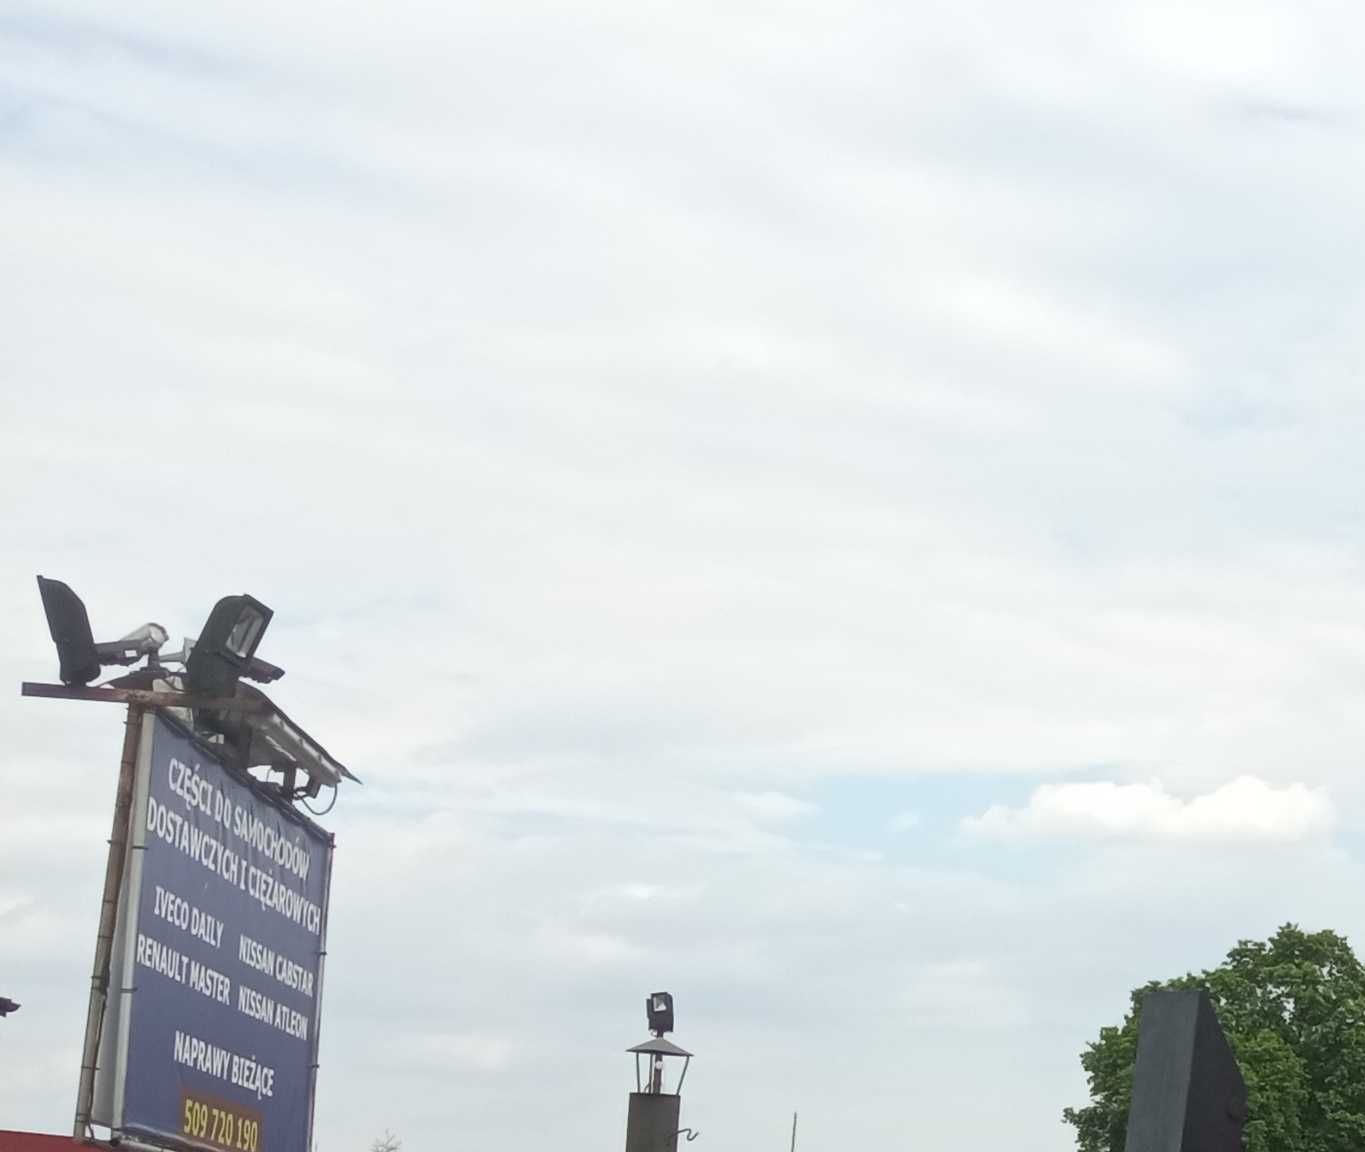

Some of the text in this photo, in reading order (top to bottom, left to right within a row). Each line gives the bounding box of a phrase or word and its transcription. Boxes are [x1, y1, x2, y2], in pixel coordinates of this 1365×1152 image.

[168, 757, 310, 881] CZĘŚCI DO SAMOCHODÓW
[147, 796, 321, 936] DOSTAWCZYCH I CIĘŻAROWYCH
[154, 885, 224, 948] IVECO DAILY
[136, 934, 231, 1005] RENAULT MASTER
[238, 935, 313, 997] NISSAN CABSTAR
[238, 985, 308, 1041] NISSAN ATLEON
[173, 1031, 275, 1100] NAPRAWY BIEŻĄCE
[183, 1098, 258, 1152] 509 720 190
